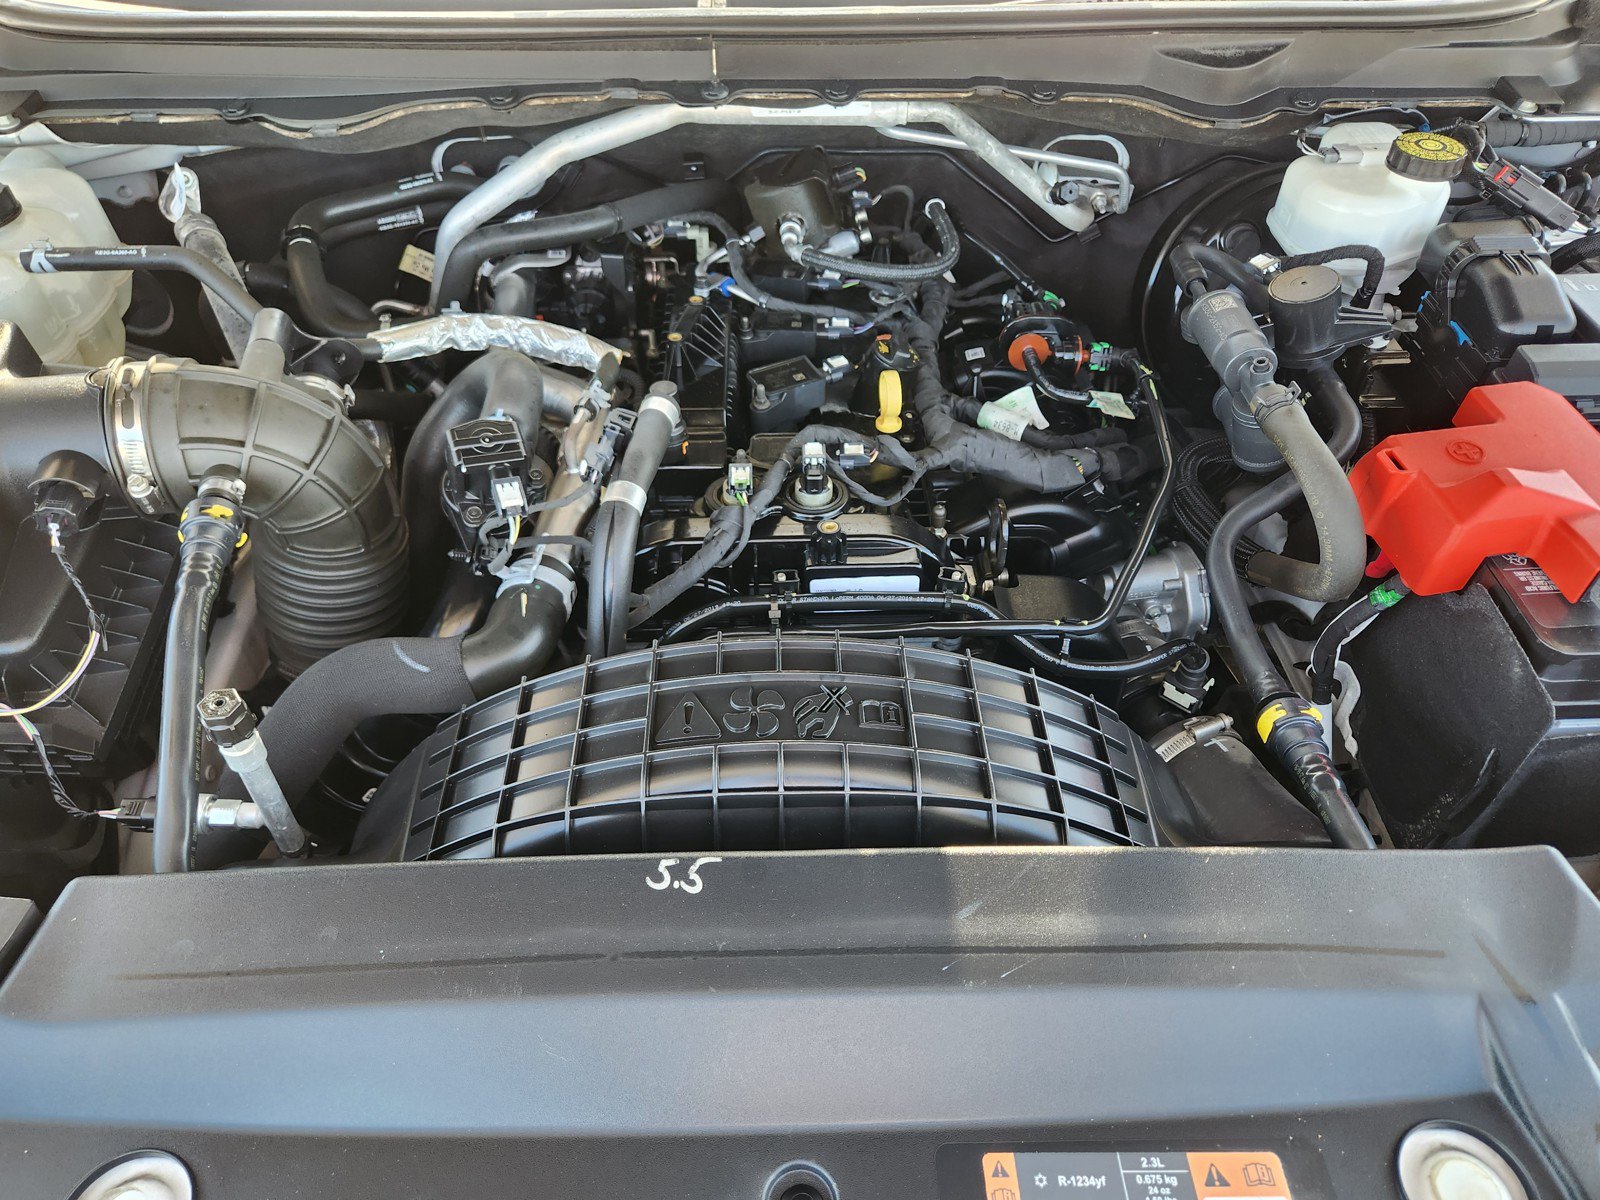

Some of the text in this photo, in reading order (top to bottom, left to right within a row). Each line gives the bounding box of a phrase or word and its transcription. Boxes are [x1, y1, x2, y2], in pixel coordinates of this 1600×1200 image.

[645, 856, 723, 894] 5.5
[1140, 1157, 1165, 1168] 2.3L
[1057, 1174, 1107, 1189] R-1234yf
[1136, 1174, 1178, 1186] 0.675 kg
[1148, 1186, 1171, 1195] 24 oz
